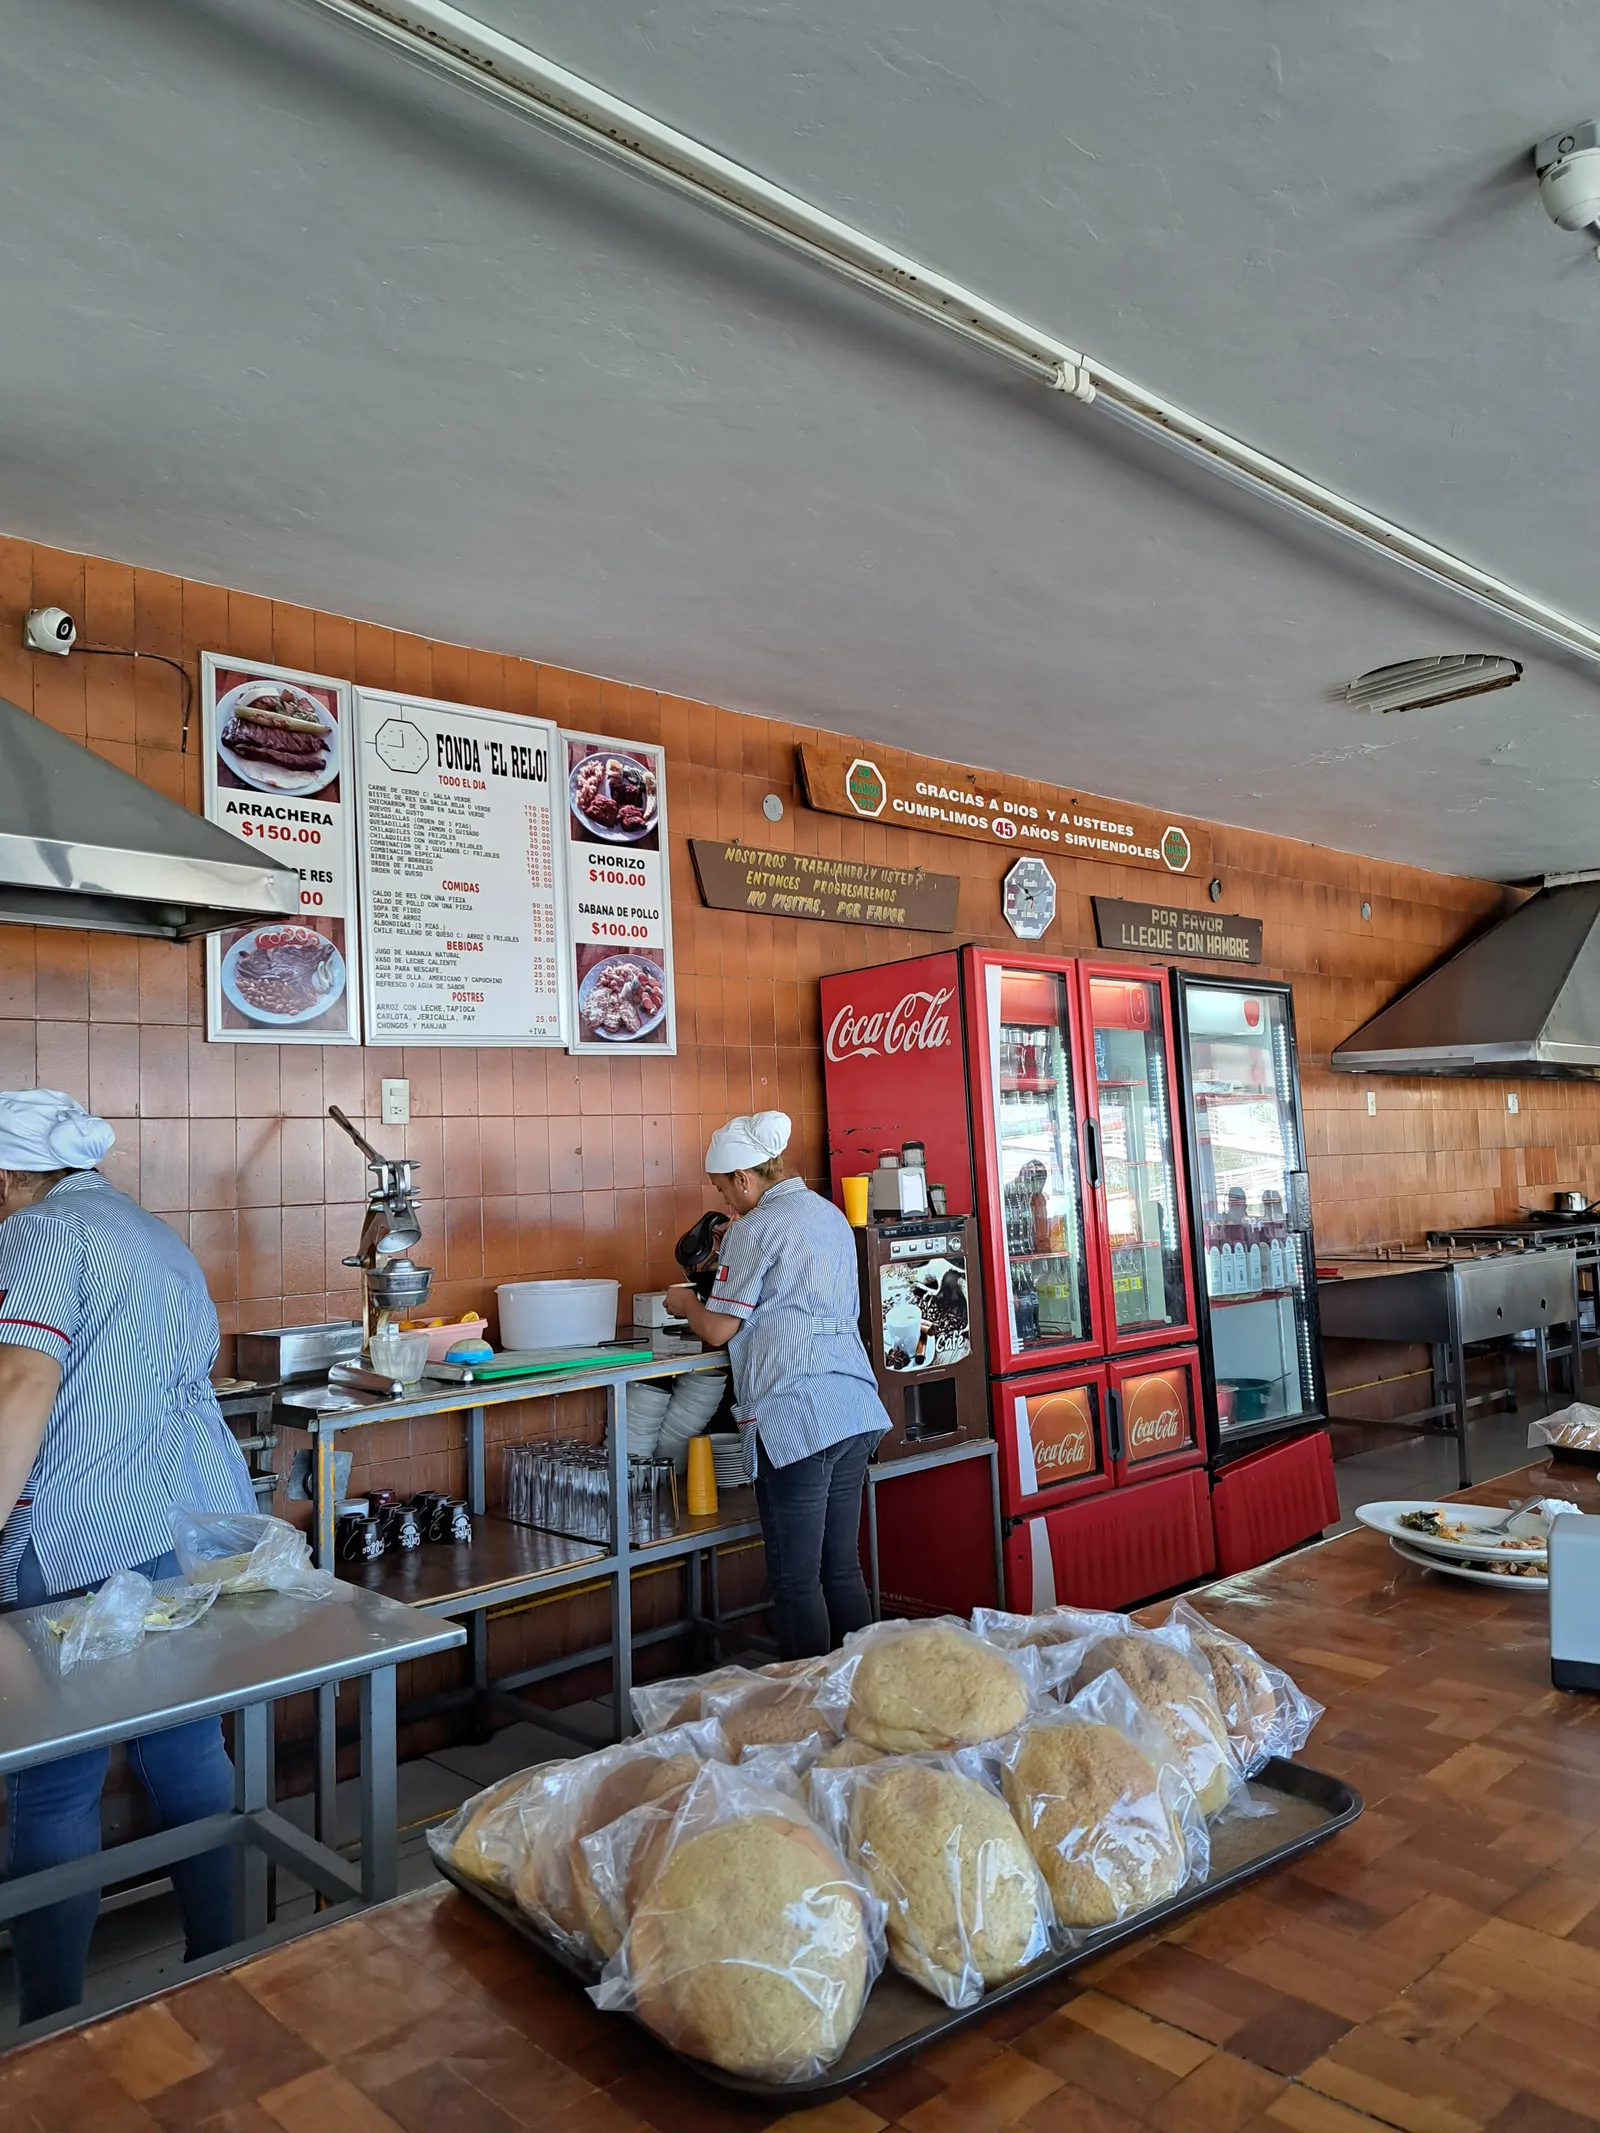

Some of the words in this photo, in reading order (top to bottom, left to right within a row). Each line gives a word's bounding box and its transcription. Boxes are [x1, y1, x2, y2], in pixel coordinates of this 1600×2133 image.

[436, 733, 481, 773] FONDA
[439, 775, 460, 786] TODO
[462, 779, 471, 788] EL
[473, 780, 486, 790] DIA
[369, 798, 405, 807] CHICHARRON
[916, 782, 985, 808] GRACIAS
[989, 799, 999, 811] A
[1003, 801, 1038, 819] DIOS
[1046, 810, 1056, 821] Y
[1060, 815, 1069, 824] A
[1073, 815, 1134, 837] USTEDES
[226, 801, 333, 826] ARRACHERA
[241, 821, 321, 844] $150.00
[370, 826, 410, 835] CHILAQUILES
[428, 832, 456, 840] FRIJOLES
[892, 799, 988, 829] CUMPLIMOS
[995, 821, 1013, 837] 45
[1020, 824, 1059, 842] AÑOS
[1065, 833, 1160, 860] SIRVIENDOLES
[370, 846, 411, 855] COMBINACION
[415, 851, 443, 859] ESPECIAL
[589, 854, 645, 869] CHORIZO
[724, 848, 786, 869] NOSOTROS
[311, 870, 333, 883] RES
[442, 880, 480, 893] COMIDAS
[589, 869, 646, 886] $100.00
[746, 870, 800, 891] ENTONCES
[813, 882, 897, 903] PROGRESAREMOS
[579, 903, 614, 916] SABANA
[617, 907, 628, 917] DE
[631, 908, 659, 919] POLLO
[836, 901, 860, 918] POR
[866, 904, 907, 924] FAVOR
[1151, 909, 1177, 927] POR
[1182, 914, 1223, 933] FAVOR
[591, 922, 648, 938] $100.00
[447, 941, 483, 951] BEBIDAS
[1178, 932, 1203, 952] CON
[1207, 935, 1249, 958] HAMBRE
[452, 992, 484, 1002] POSTRES
[827, 986, 956, 1062] Coca-Cola
[935, 1327, 965, 1353] Café
[1132, 1408, 1180, 1446] Coca-Cola
